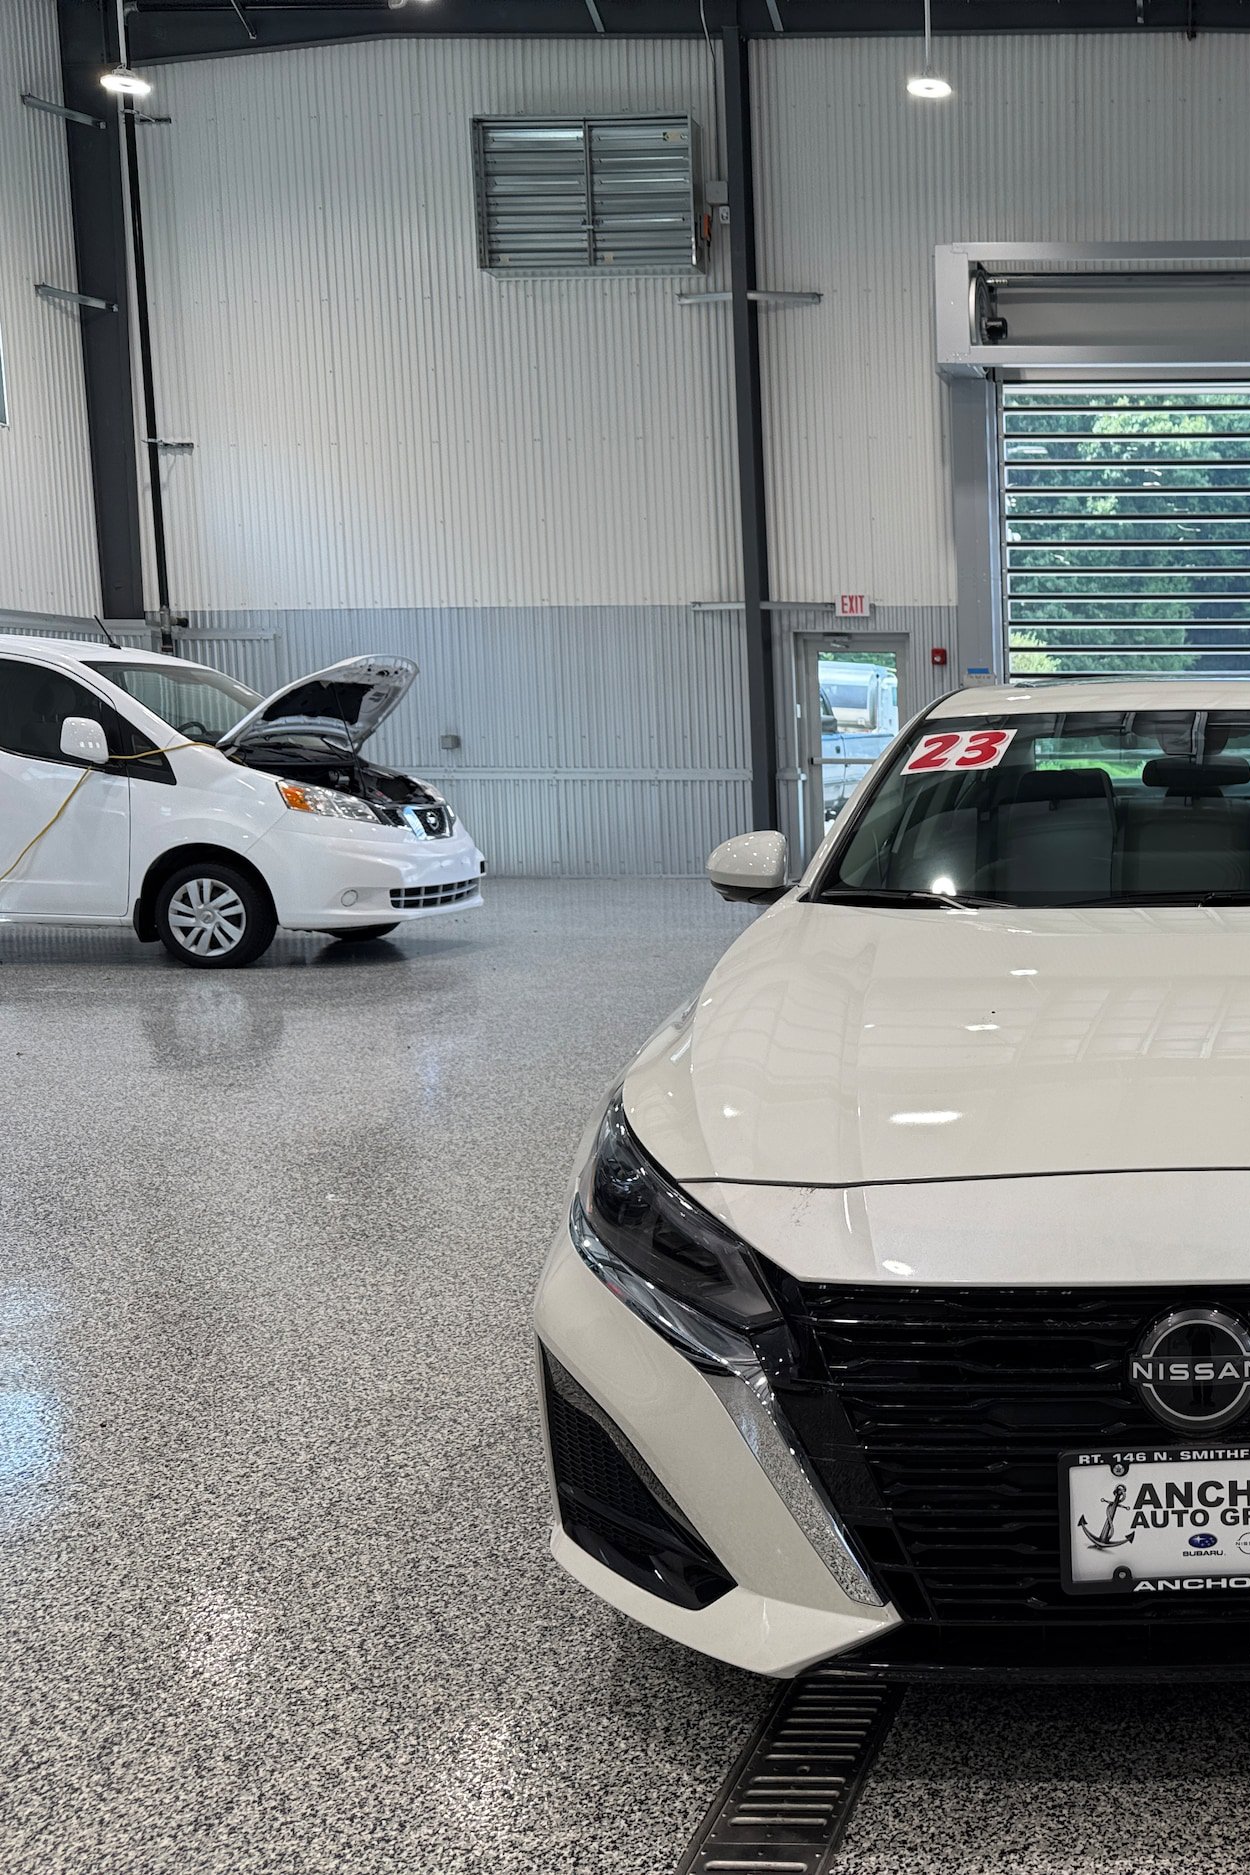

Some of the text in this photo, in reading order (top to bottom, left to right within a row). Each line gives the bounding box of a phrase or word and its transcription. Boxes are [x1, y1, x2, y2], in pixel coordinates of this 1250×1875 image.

[841, 595, 865, 614] EXIT
[908, 731, 1007, 770] 23
[1078, 1454, 1104, 1465] RT.
[1112, 1452, 1147, 1463] 146
[1153, 1451, 1173, 1461] N.
[1131, 1508, 1209, 1528] AUTO
[1182, 1549, 1224, 1557] SUBARU
